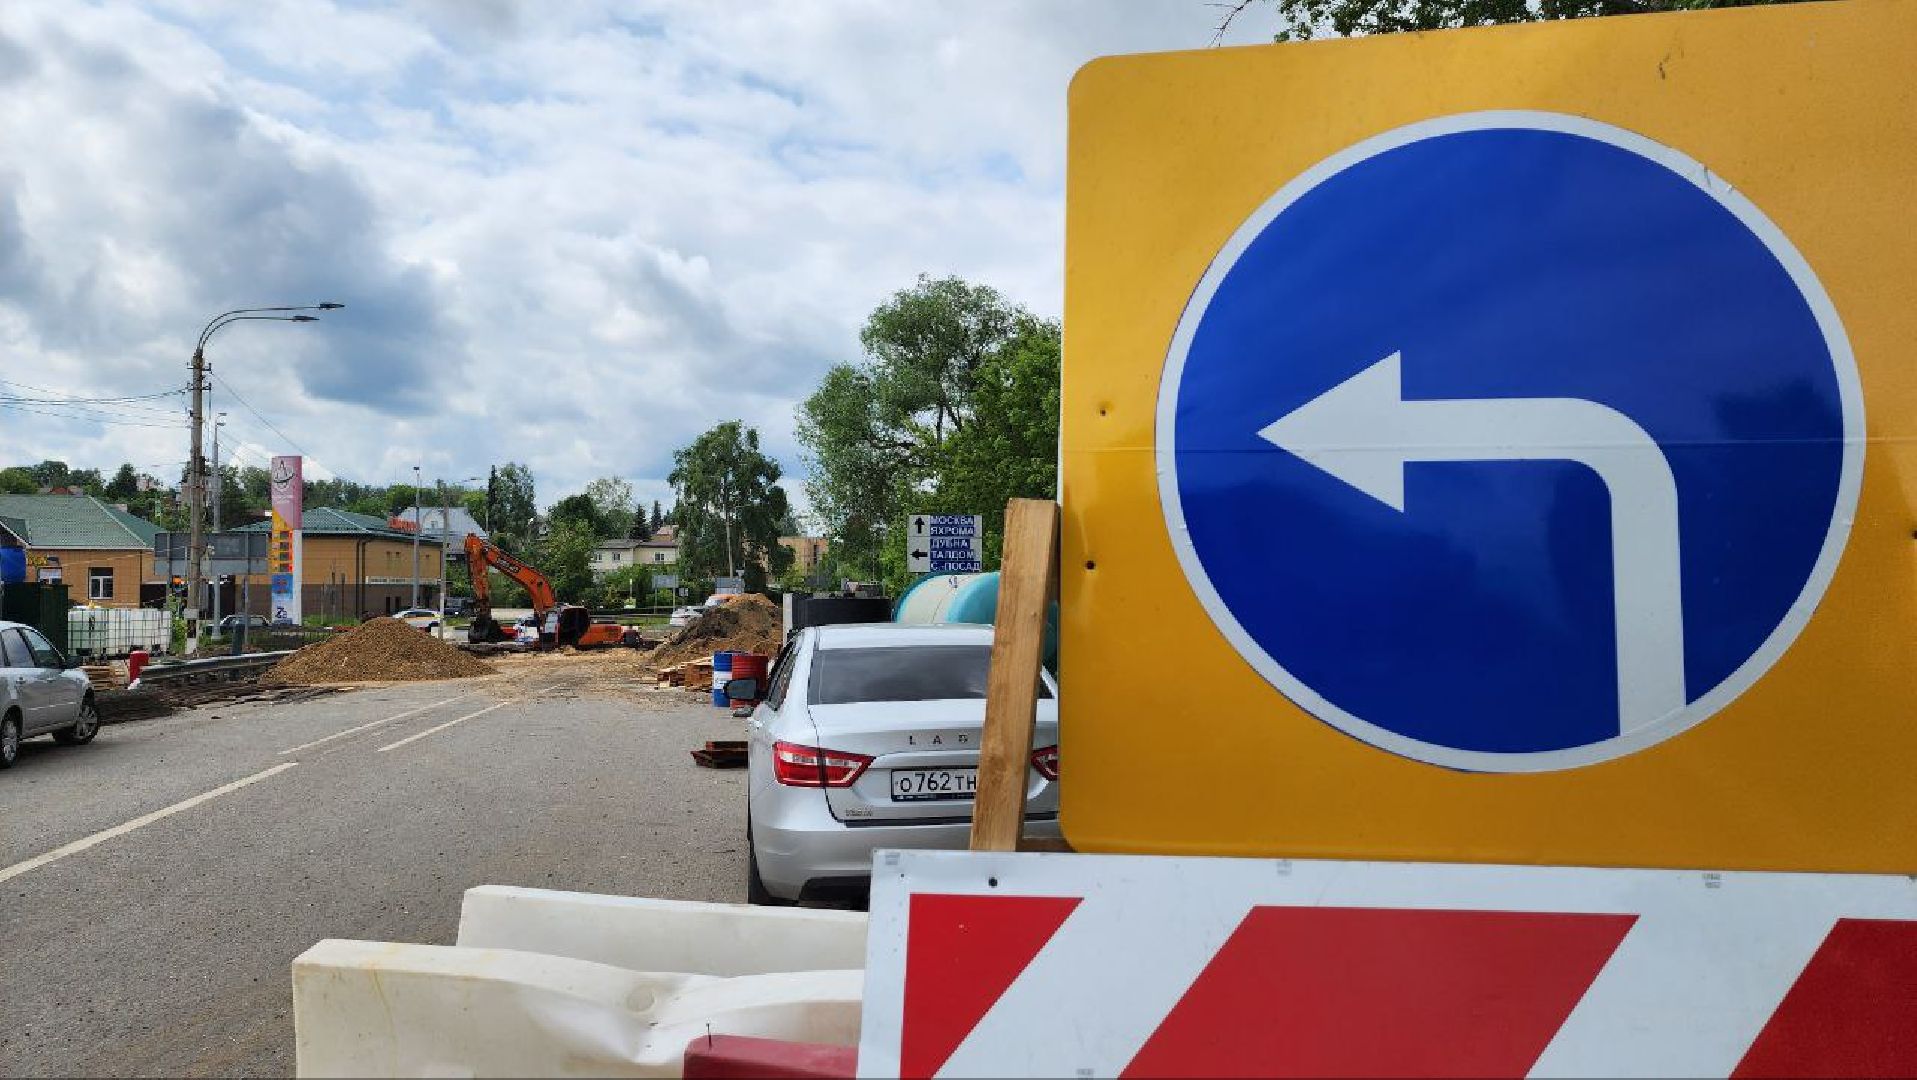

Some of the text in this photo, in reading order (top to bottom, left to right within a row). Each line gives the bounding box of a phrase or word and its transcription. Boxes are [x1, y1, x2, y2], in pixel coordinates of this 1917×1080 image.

[930, 515, 974, 524] МОСКВА
[930, 526, 974, 535] ЯХРОМА
[932, 539, 968, 549] ДУБНА
[930, 550, 974, 560] ТАЛДОМ
